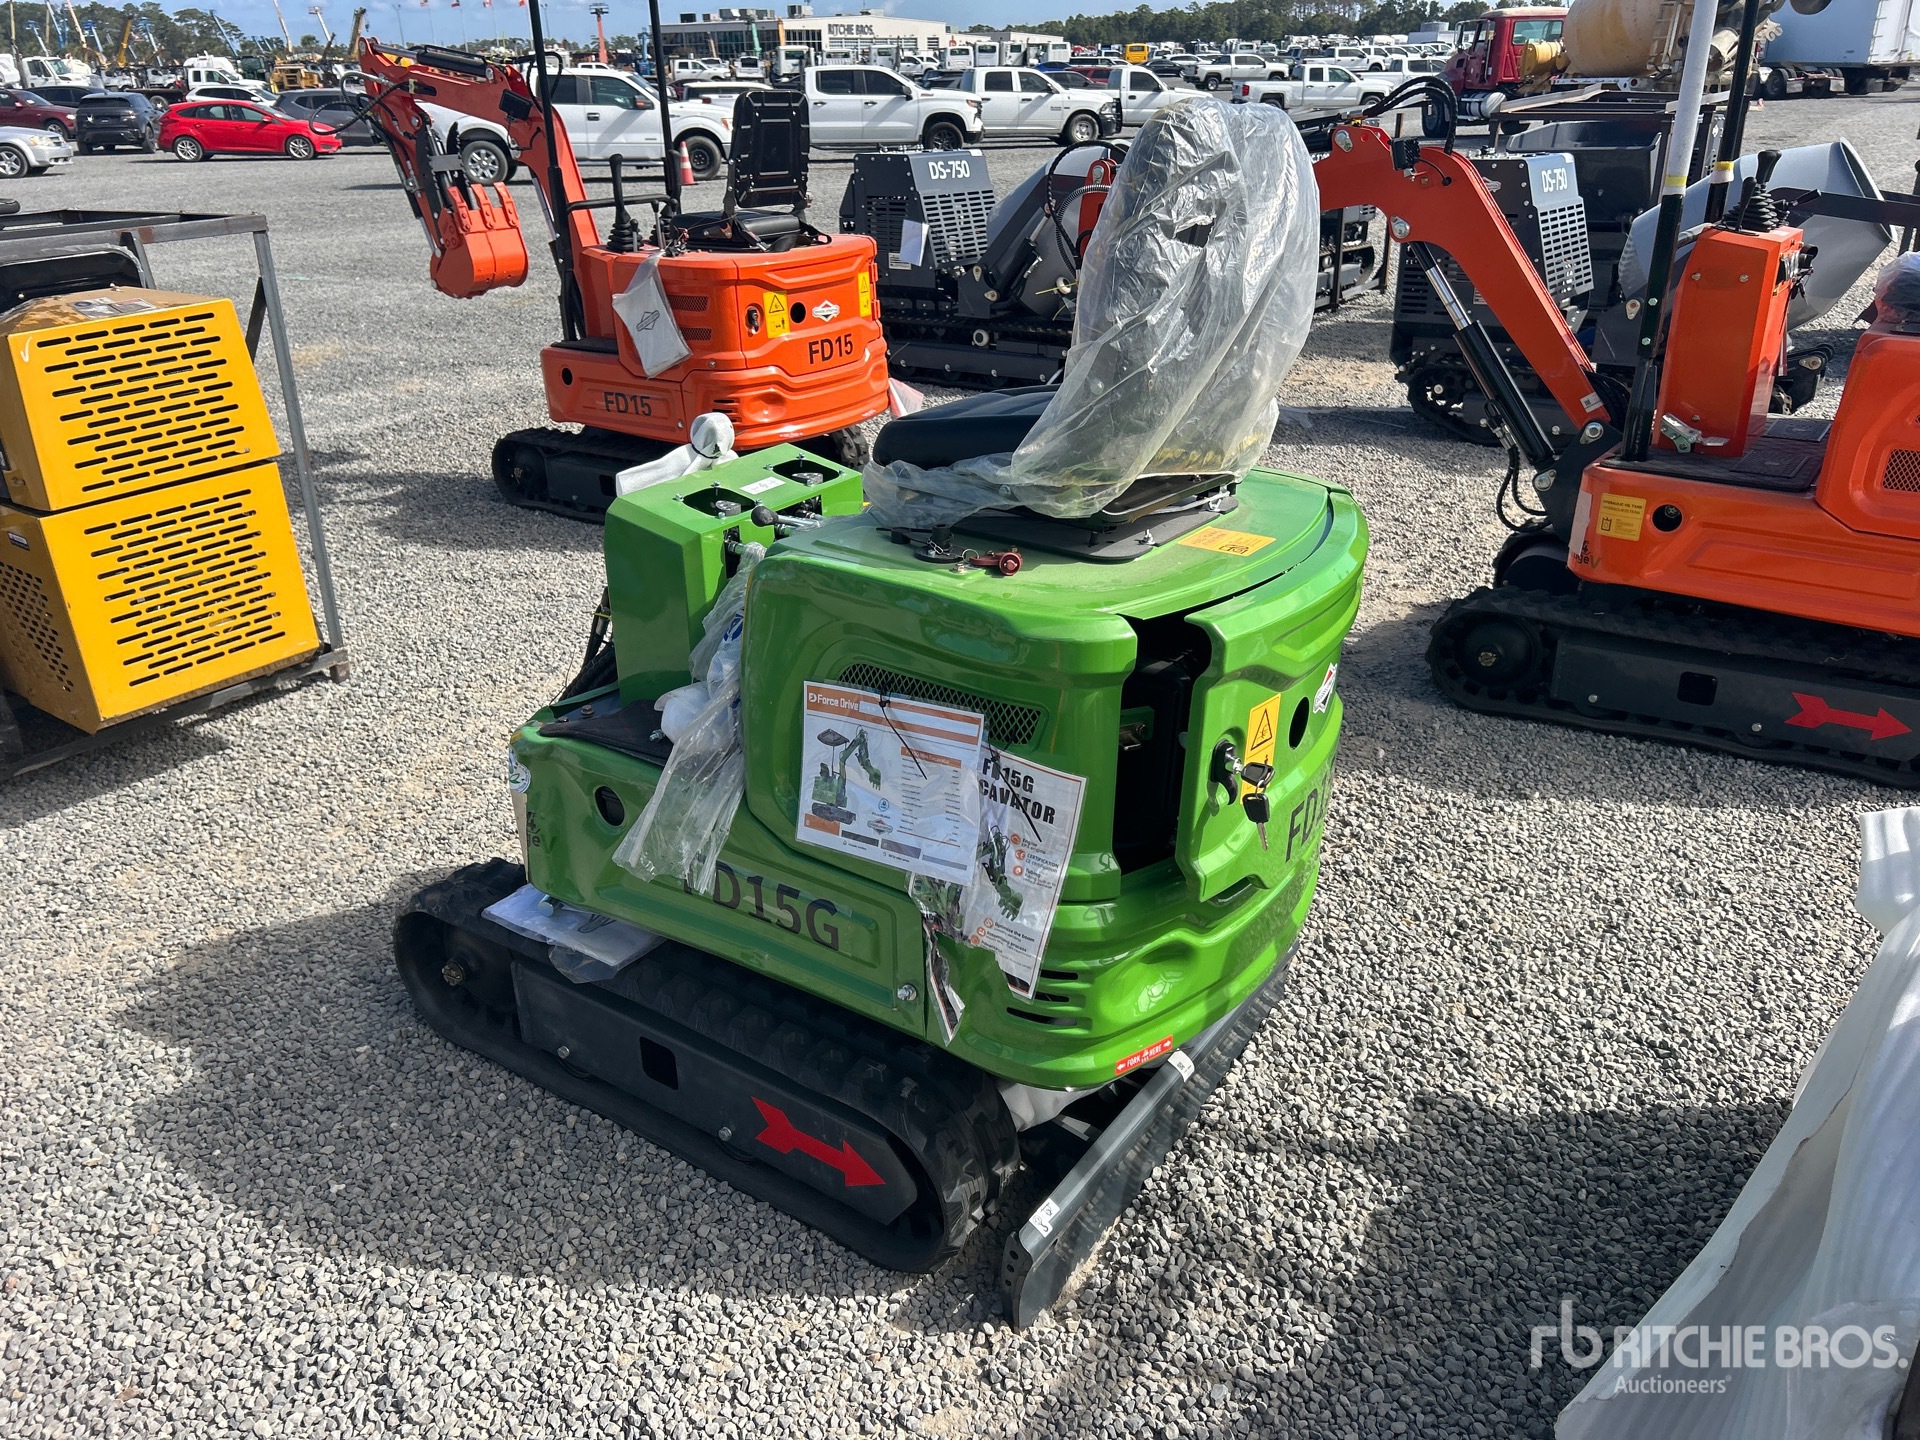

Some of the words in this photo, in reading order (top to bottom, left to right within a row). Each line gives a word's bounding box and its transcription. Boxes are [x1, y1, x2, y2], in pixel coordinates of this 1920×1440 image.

[928, 160, 971, 180] DS-750
[1541, 168, 1568, 193] DS-750
[808, 333, 853, 365] FD15
[603, 391, 652, 417] FD15
[817, 694, 839, 707] Force
[840, 698, 859, 711] Drive
[1126, 1055, 1141, 1068] FORK
